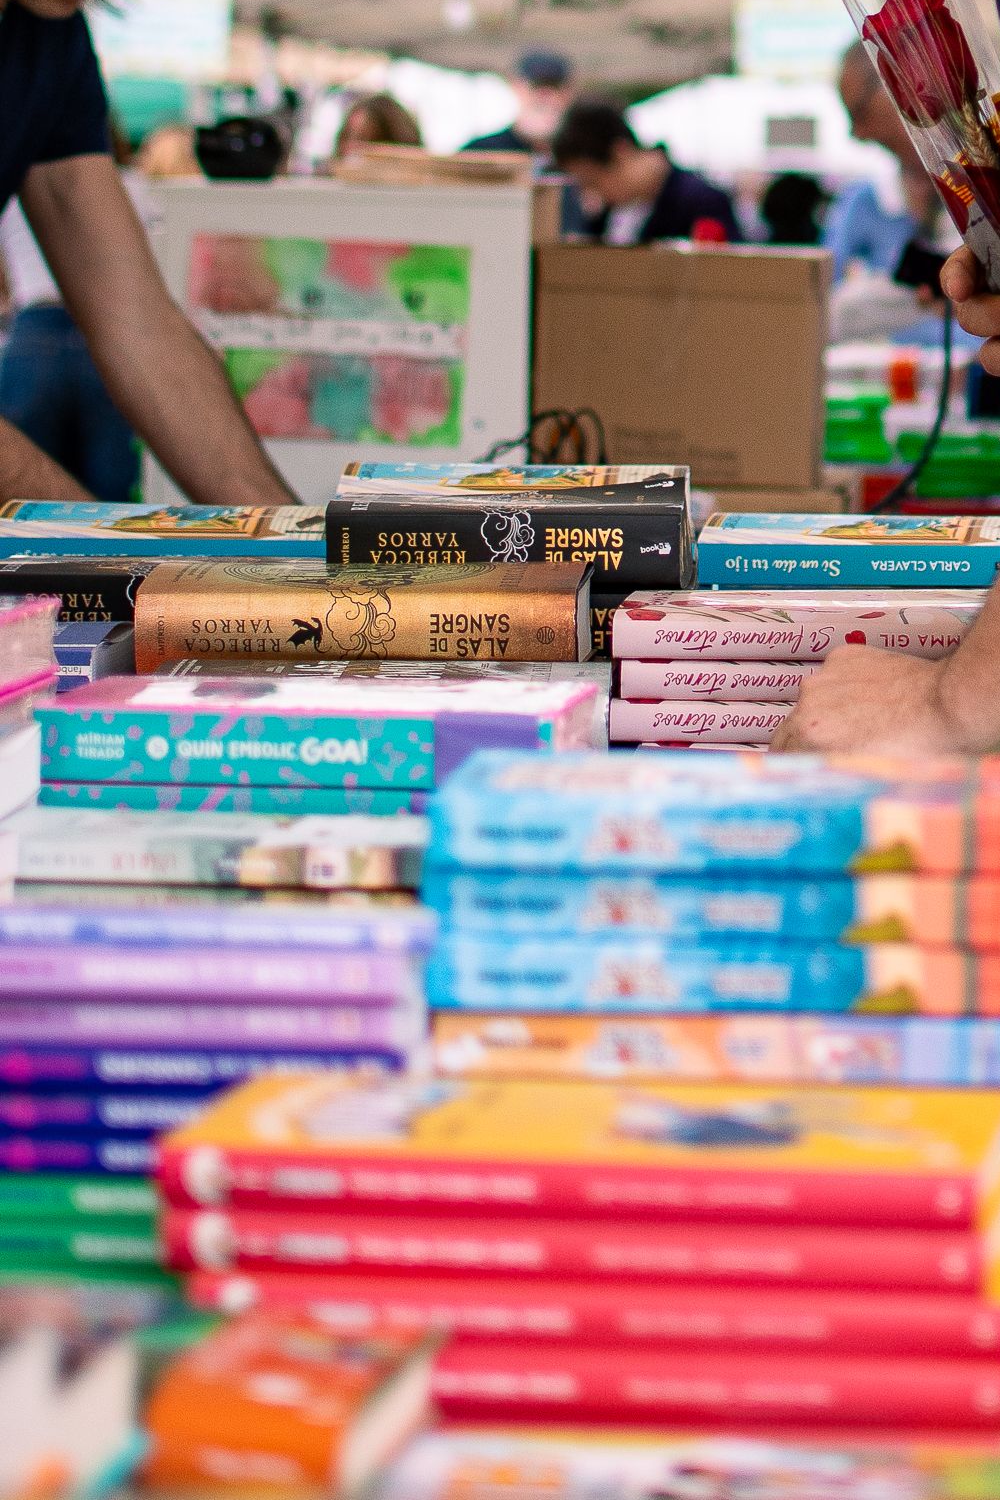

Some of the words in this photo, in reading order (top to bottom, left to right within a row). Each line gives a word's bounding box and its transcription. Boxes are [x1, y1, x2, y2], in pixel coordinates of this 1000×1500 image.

[377, 531, 457, 547] YARROS
[545, 527, 624, 548] SANGRE
[369, 550, 466, 565] REBECCA
[545, 551, 564, 564] DE
[571, 551, 624, 570] ALAS
[752, 559, 769, 571] tu
[799, 559, 819, 569] un
[870, 560, 927, 572] CLAVERA
[929, 560, 971, 572] CARLA
[821, 559, 841, 577] Si
[191, 619, 273, 634] YARROS
[429, 613, 510, 634] SANGRE
[183, 637, 282, 653] REBECCA
[429, 637, 448, 652] DE
[455, 637, 509, 657] ALAS
[654, 629, 717, 653] eternos
[721, 625, 804, 654] fuéramos
[809, 626, 834, 653] Si
[879, 634, 910, 648] GIL
[917, 634, 961, 648] MMA
[664, 672, 727, 695] eternos
[731, 670, 808, 692] uéramos
[653, 712, 716, 736] eternos
[720, 714, 786, 733] éramos
[177, 739, 224, 759] QUIN
[228, 739, 297, 761] EMBOLIC
[299, 737, 368, 765] GOA!
